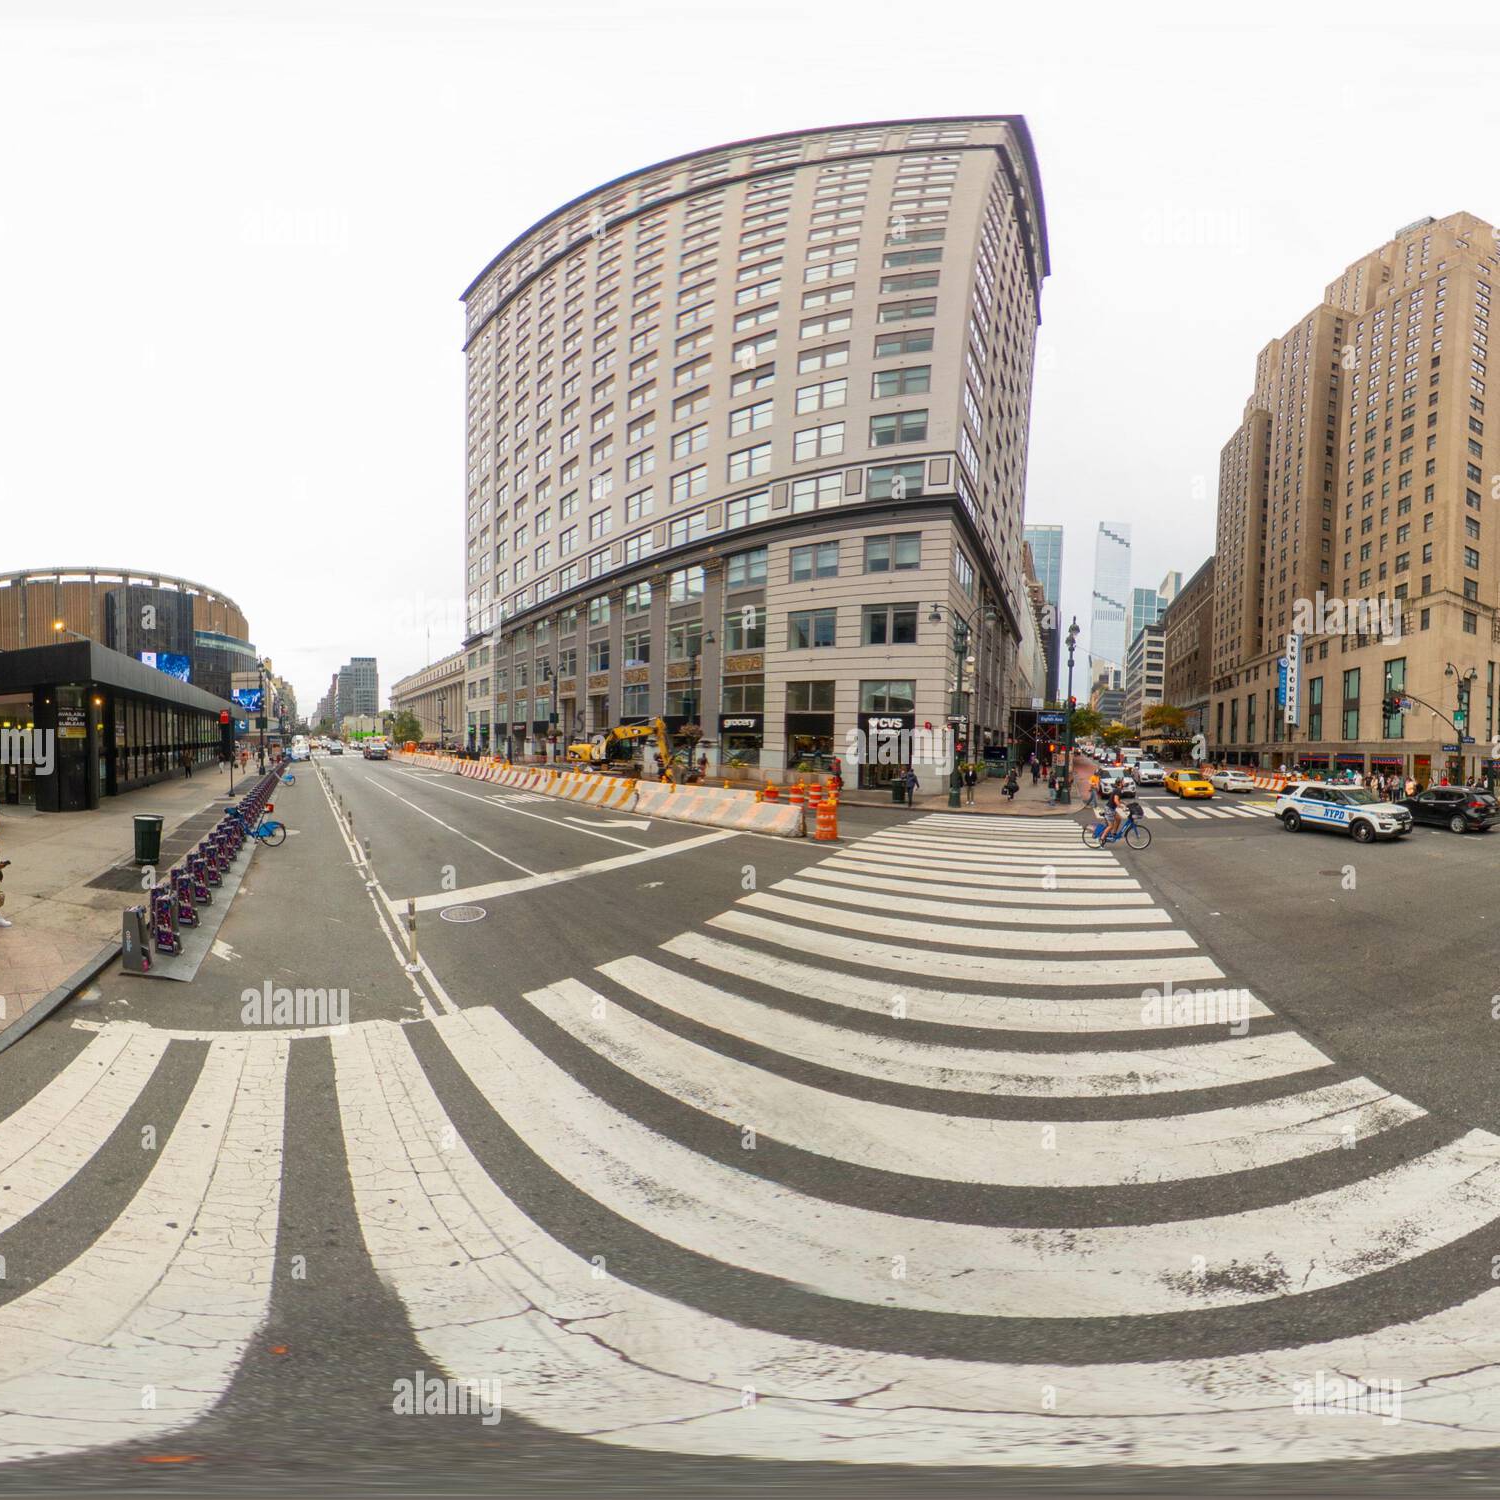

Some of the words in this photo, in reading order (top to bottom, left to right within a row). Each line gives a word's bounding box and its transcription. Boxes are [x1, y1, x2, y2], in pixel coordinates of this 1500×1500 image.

[1289, 637, 1297, 660] NEW
[1288, 666, 1296, 721] YORKER
[724, 719, 756, 728] grocery
[879, 718, 903, 728] CVS
[1323, 808, 1345, 820] NYPD
